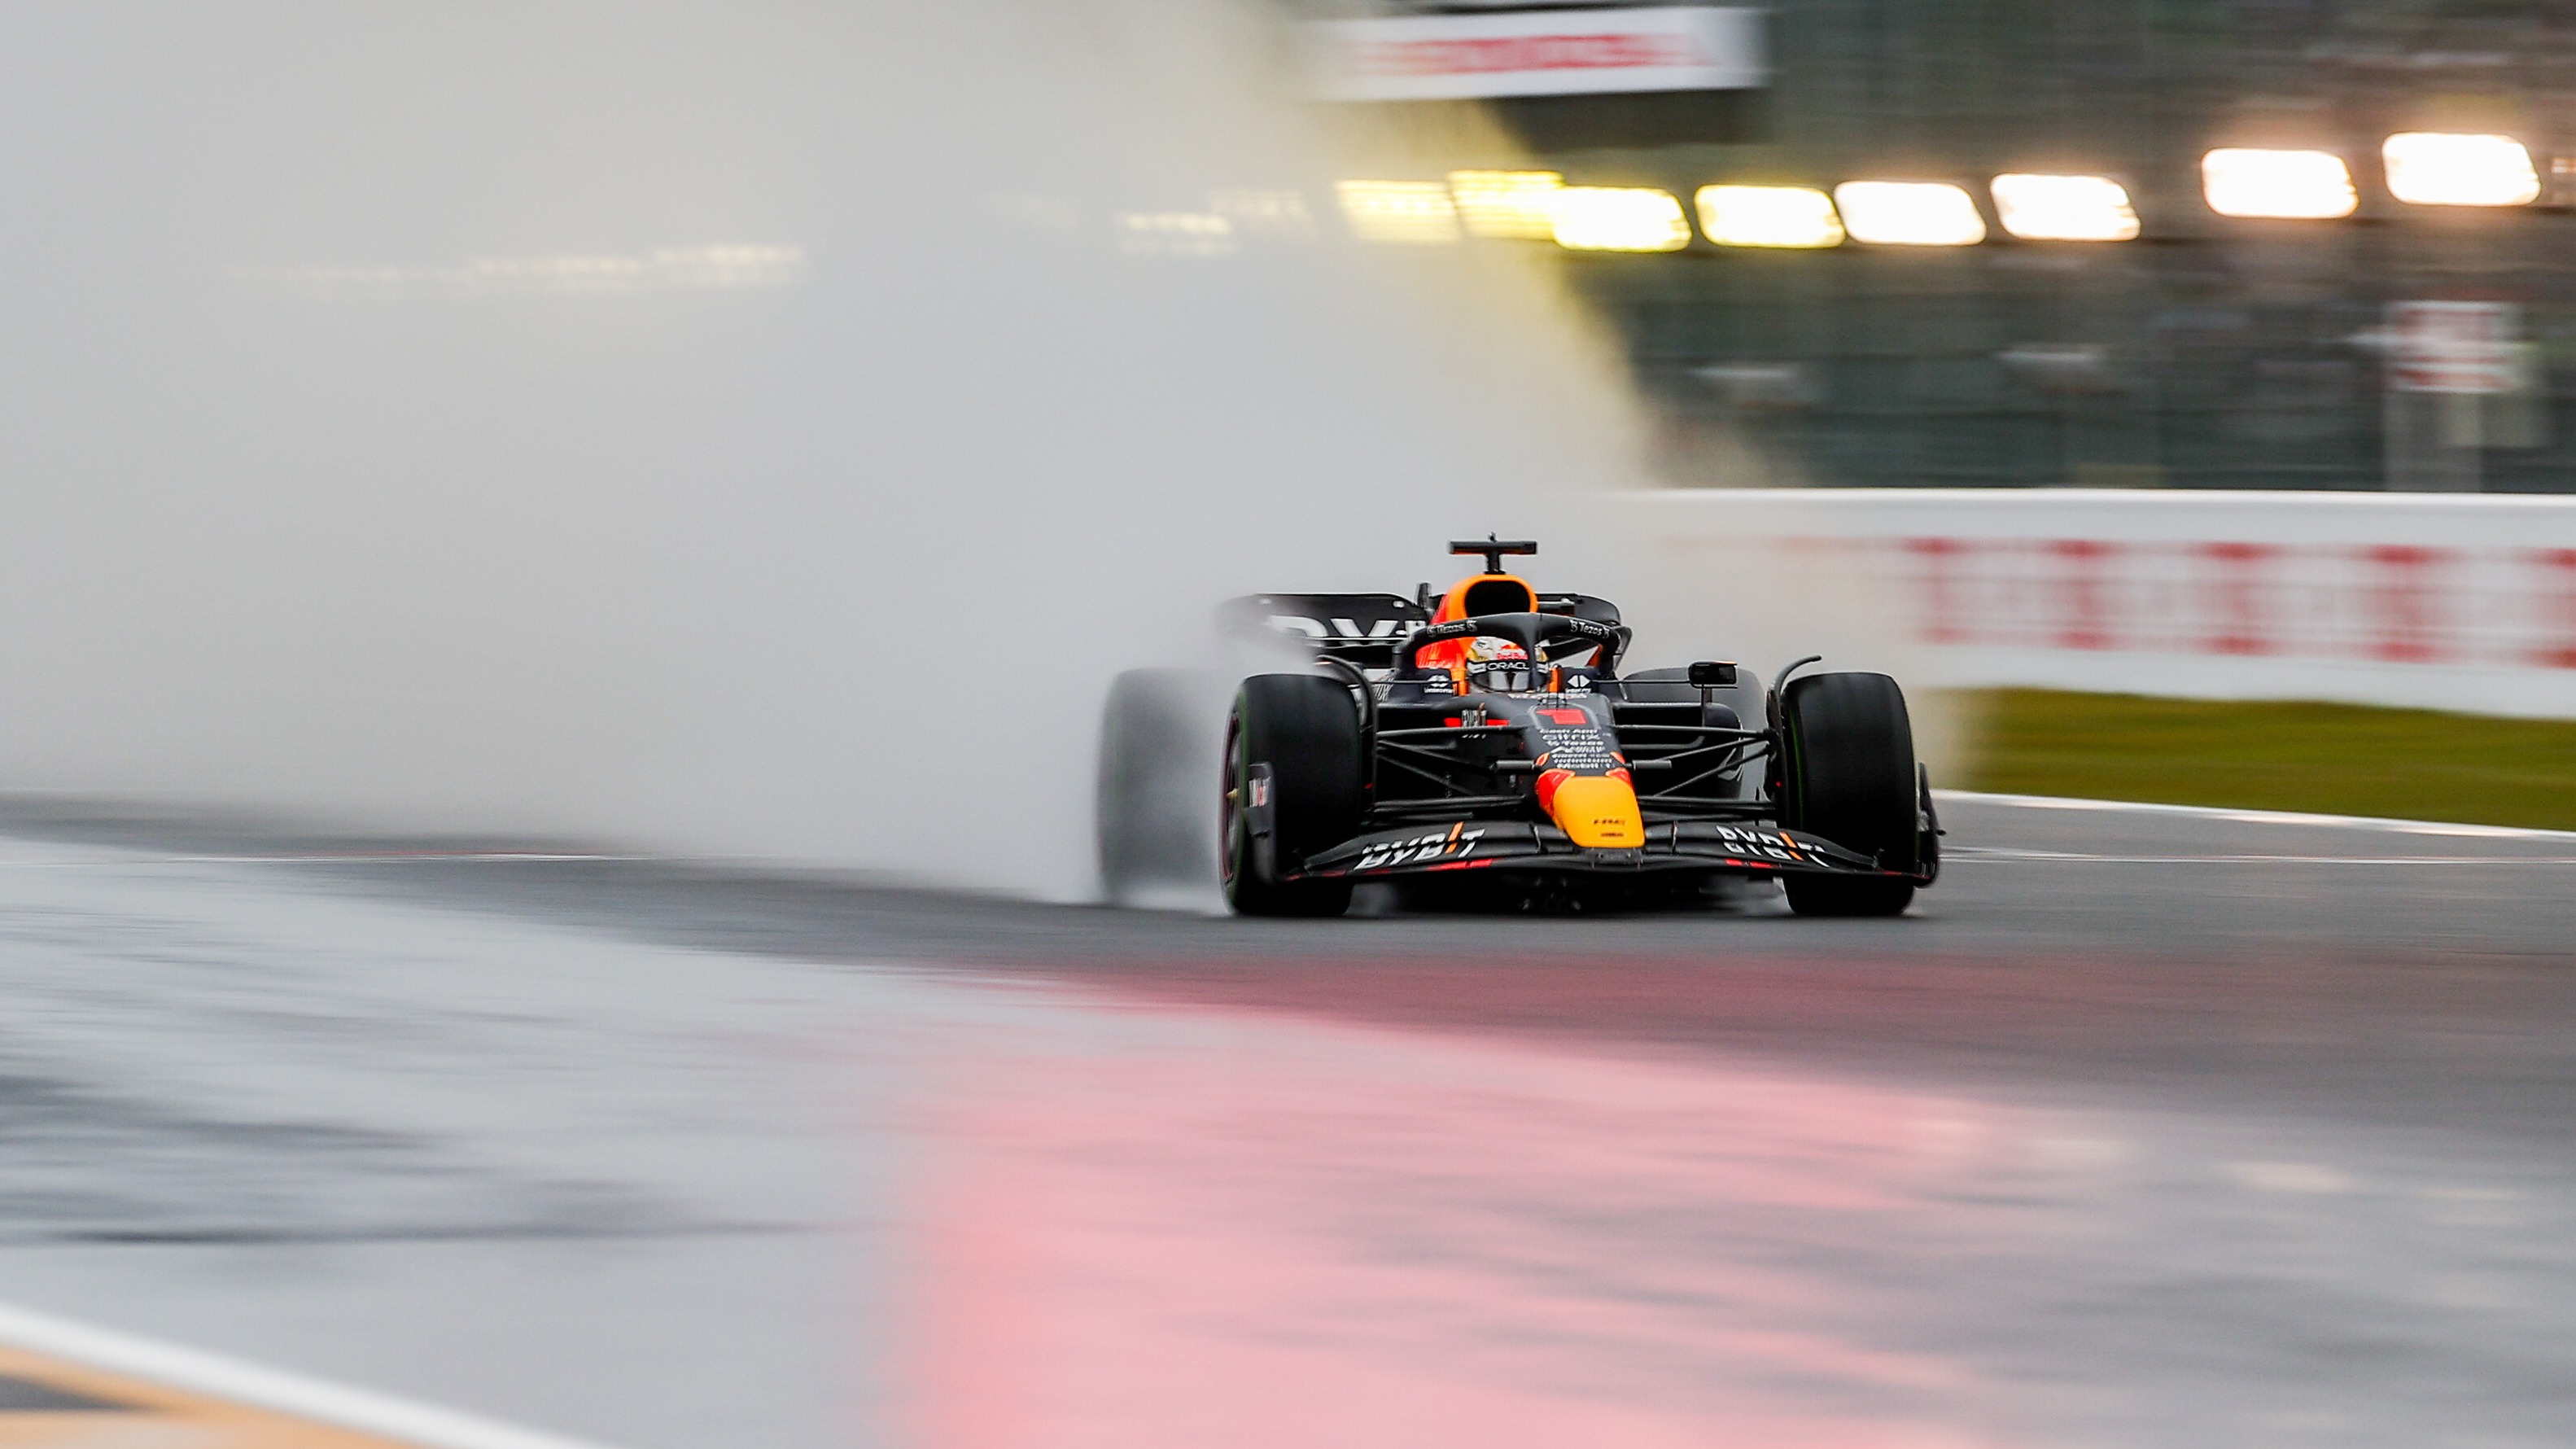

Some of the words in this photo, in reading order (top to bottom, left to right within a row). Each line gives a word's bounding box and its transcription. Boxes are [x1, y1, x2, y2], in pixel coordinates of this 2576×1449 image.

[1579, 621, 1603, 637] Tezos
[1486, 661, 1530, 671] ORACL
[1535, 708, 1588, 724] 1
